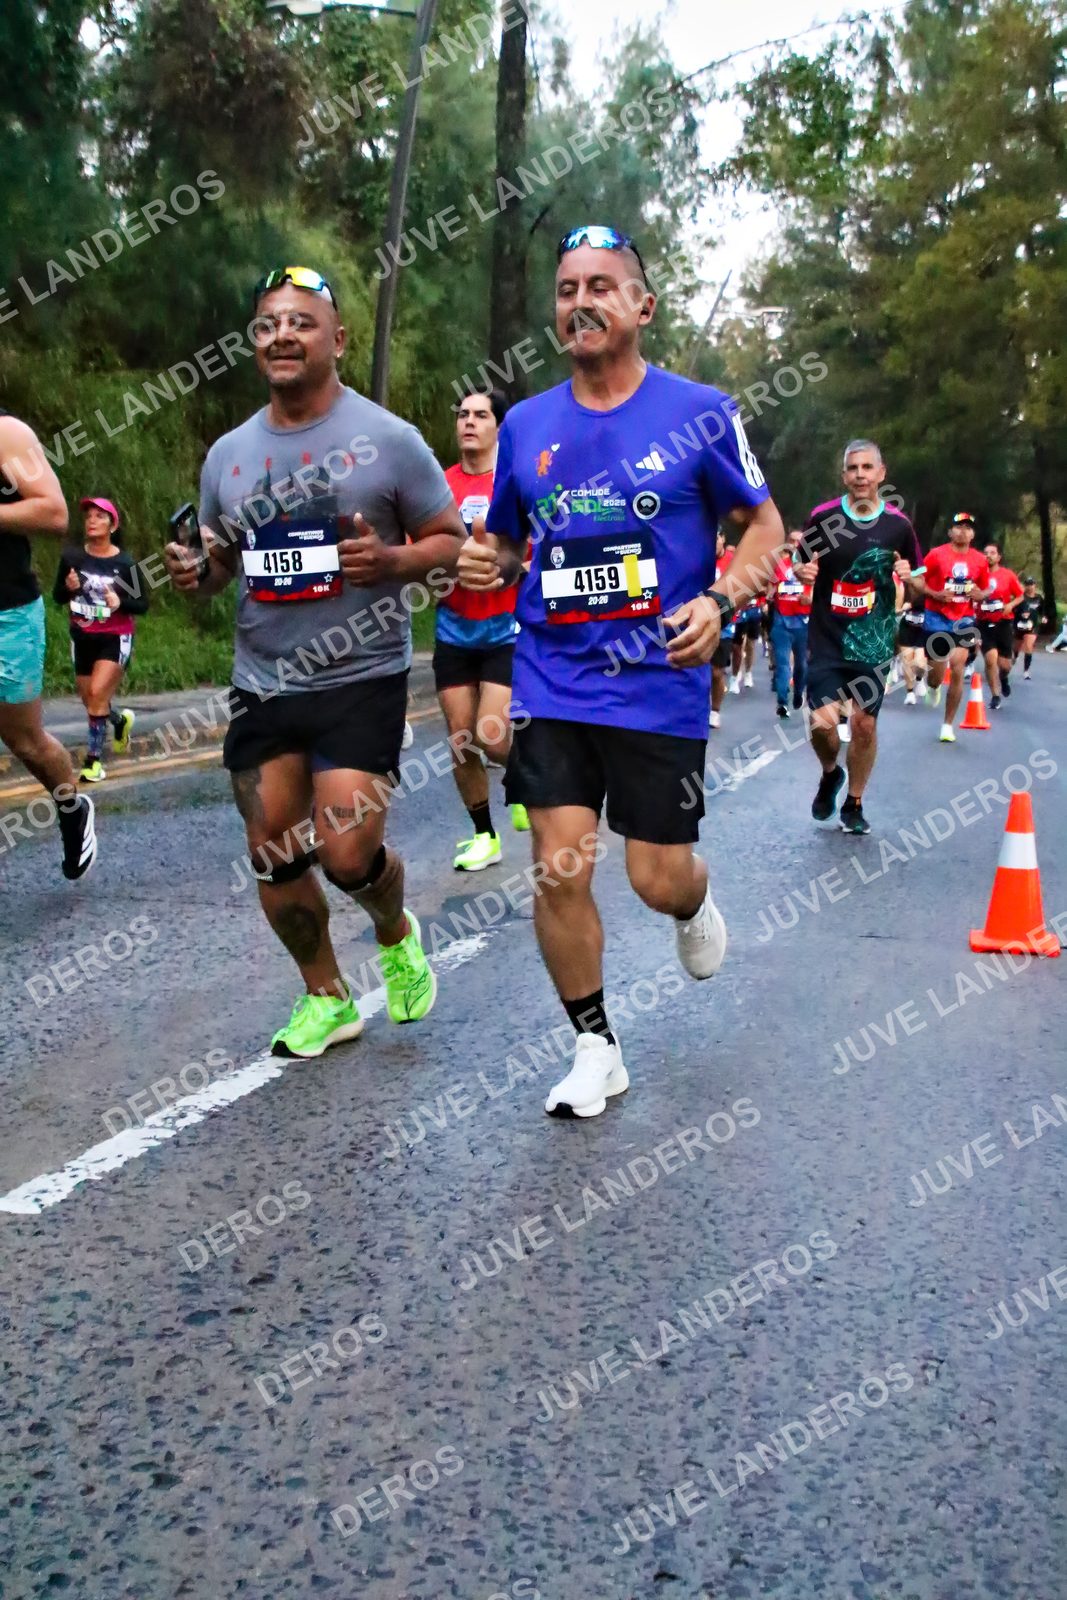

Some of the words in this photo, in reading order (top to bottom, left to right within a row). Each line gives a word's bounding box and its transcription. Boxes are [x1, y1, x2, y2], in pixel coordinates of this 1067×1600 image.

[570, 488, 610, 497] COMUDE
[263, 550, 303, 573] 4158
[574, 566, 620, 592] 4159
[313, 584, 330, 593] 10K
[631, 601, 649, 611] 10K
[842, 596, 864, 607] 3504
